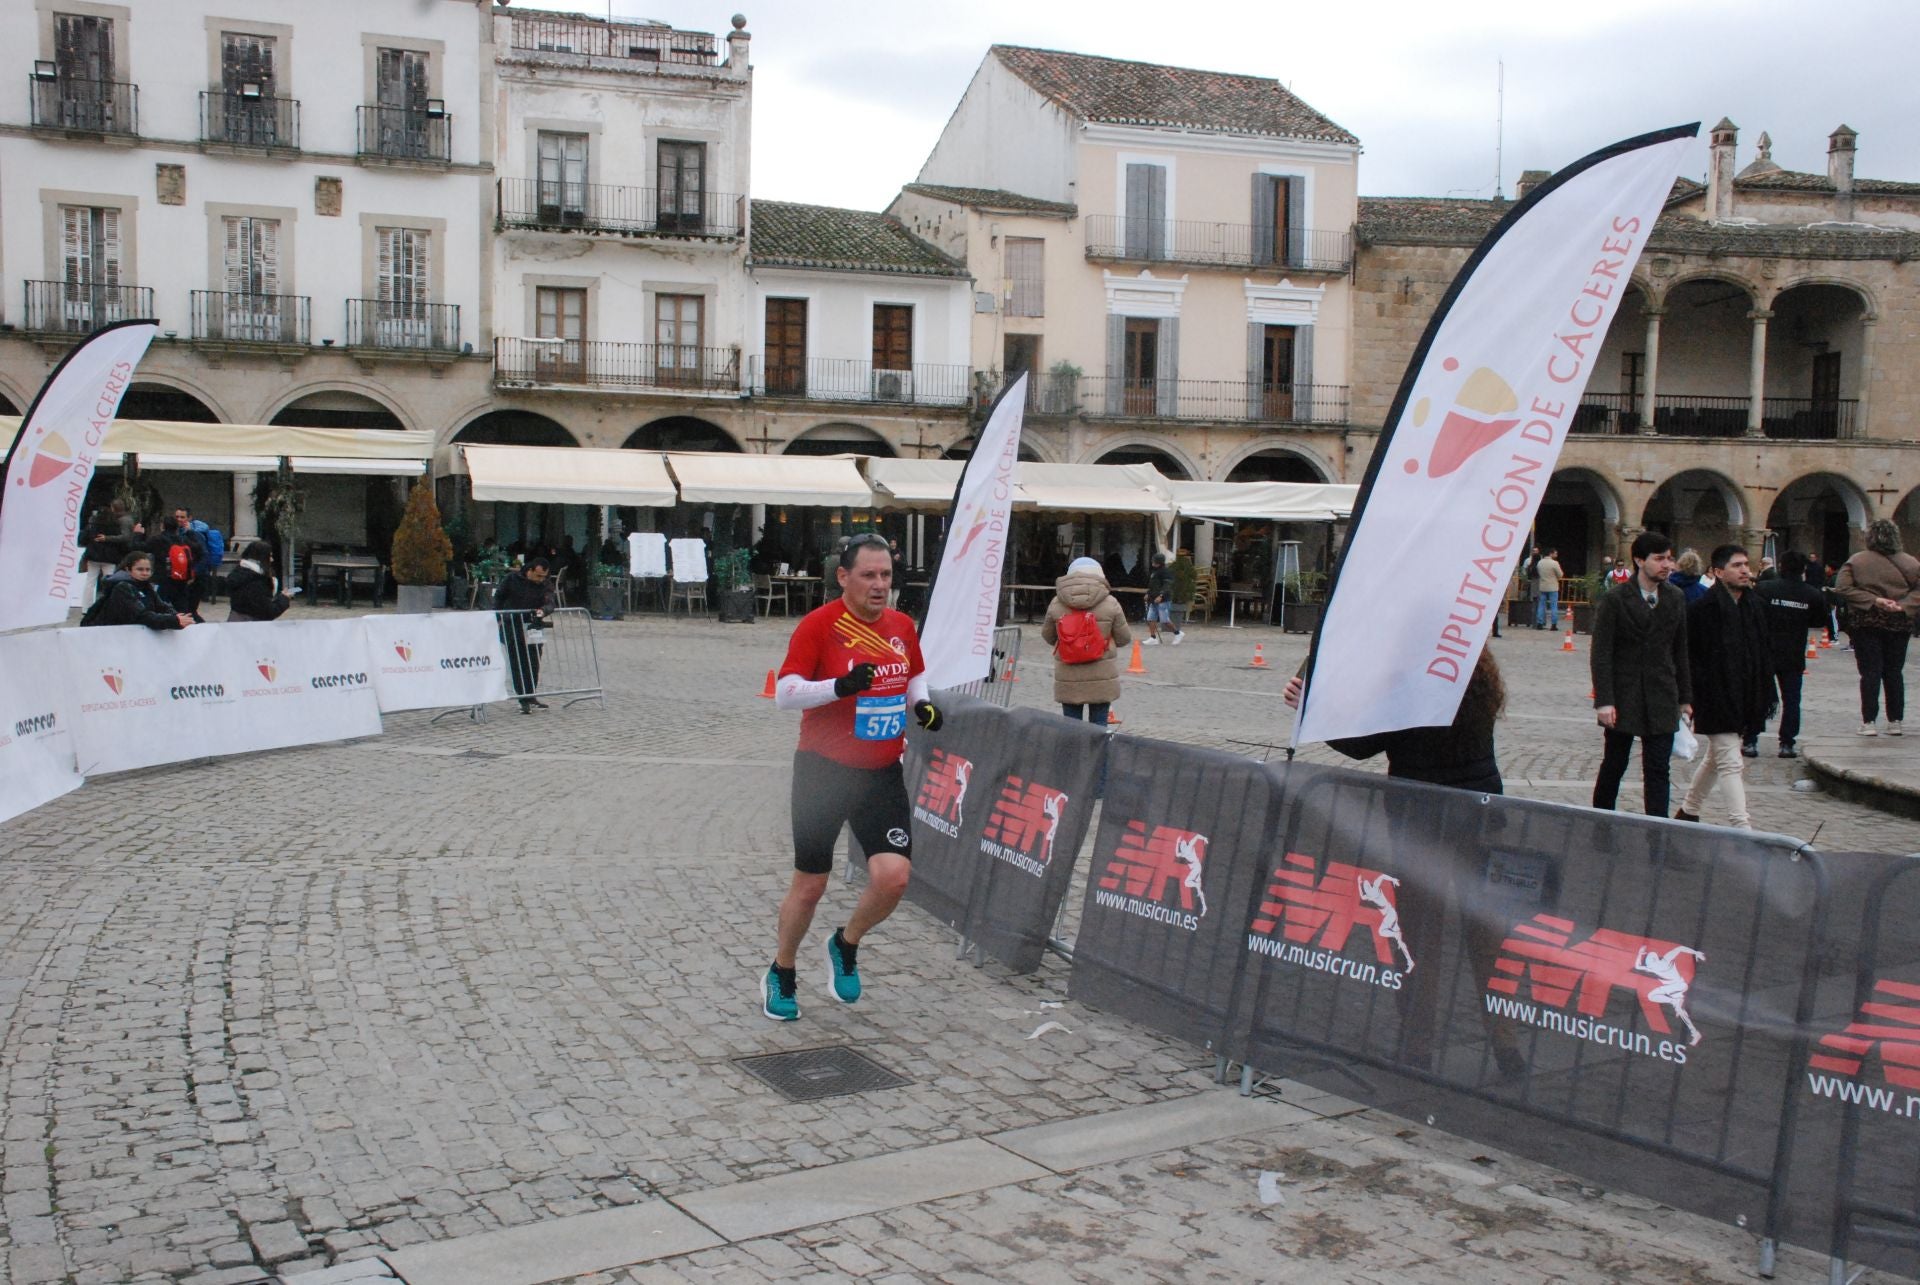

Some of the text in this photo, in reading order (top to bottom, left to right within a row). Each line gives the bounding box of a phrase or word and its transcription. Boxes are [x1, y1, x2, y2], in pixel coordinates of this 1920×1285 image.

[1427, 215, 1641, 684] DIPUTACIÓN DE CÁCERES
[48, 360, 132, 600] DIPUTACIÓN DE CÁCERES
[971, 538, 1002, 657] DIPUTACIÓN
[990, 509, 1006, 535] DE
[867, 715, 900, 737] 575
[913, 805, 959, 839] www.musicrun.es
[980, 838, 1046, 879] www.musicrun.es
[1096, 888, 1198, 932] www.musicrun.es
[1248, 934, 1402, 991] www.musicrun.es
[1485, 993, 1688, 1065] www.musicrun.es
